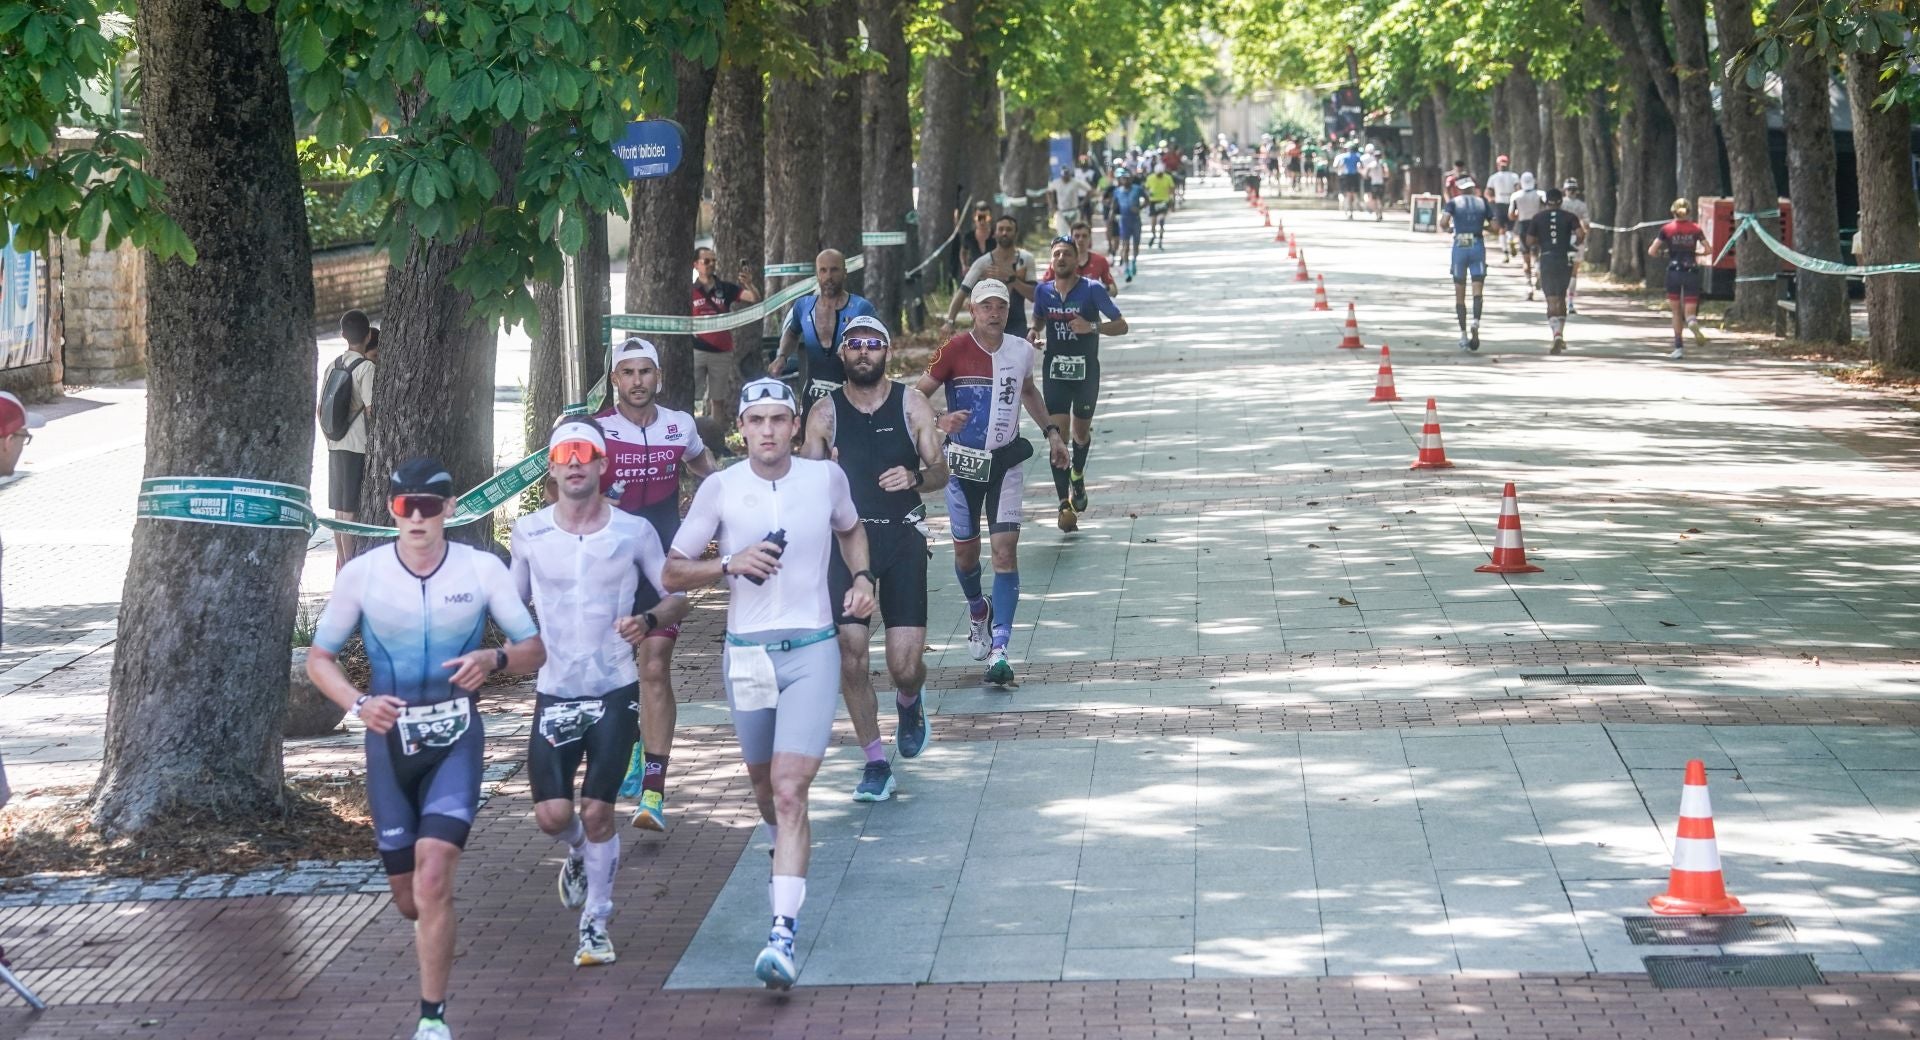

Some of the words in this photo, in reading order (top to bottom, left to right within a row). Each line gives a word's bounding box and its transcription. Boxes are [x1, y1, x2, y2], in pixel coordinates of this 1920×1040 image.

[1056, 331, 1078, 340] ITA
[1059, 363, 1076, 371] 871
[615, 450, 674, 464] HERRERO
[955, 454, 984, 469] 1317
[615, 467, 658, 477] GETXO
